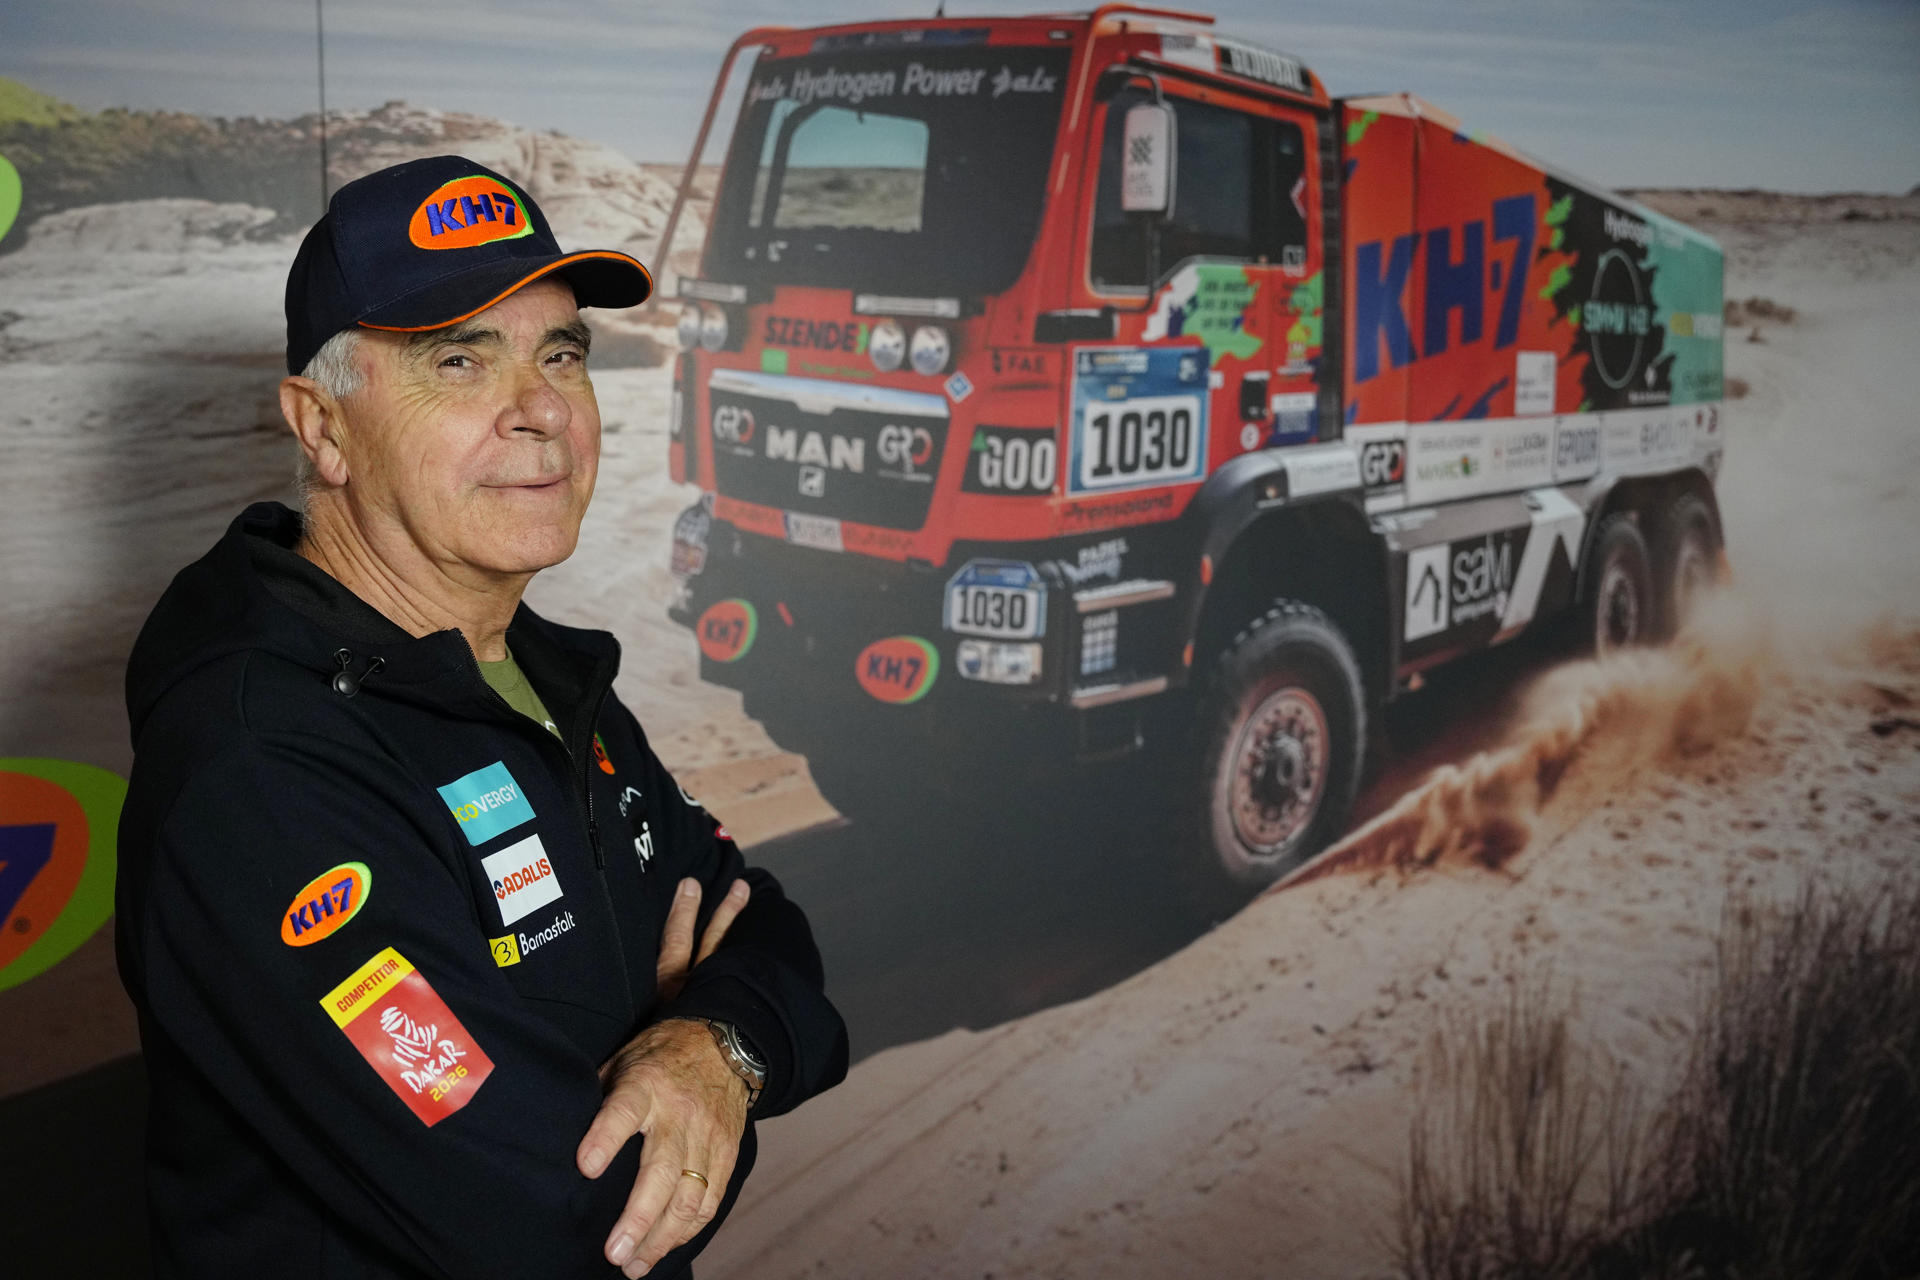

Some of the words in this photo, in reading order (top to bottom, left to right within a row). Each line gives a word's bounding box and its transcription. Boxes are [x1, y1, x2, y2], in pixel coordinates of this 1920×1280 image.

[790, 67, 896, 104] Hydrogen
[902, 62, 987, 96] Power
[765, 424, 866, 474] MAN
[1091, 408, 1192, 478] 1030
[959, 589, 1028, 631] 1030
[502, 857, 552, 896] ADALIS
[518, 910, 577, 957] Barnasfalt
[335, 958, 401, 1014] COMPETITOR
[400, 1038, 467, 1094] DAKAR
[427, 1064, 469, 1103] 2026
